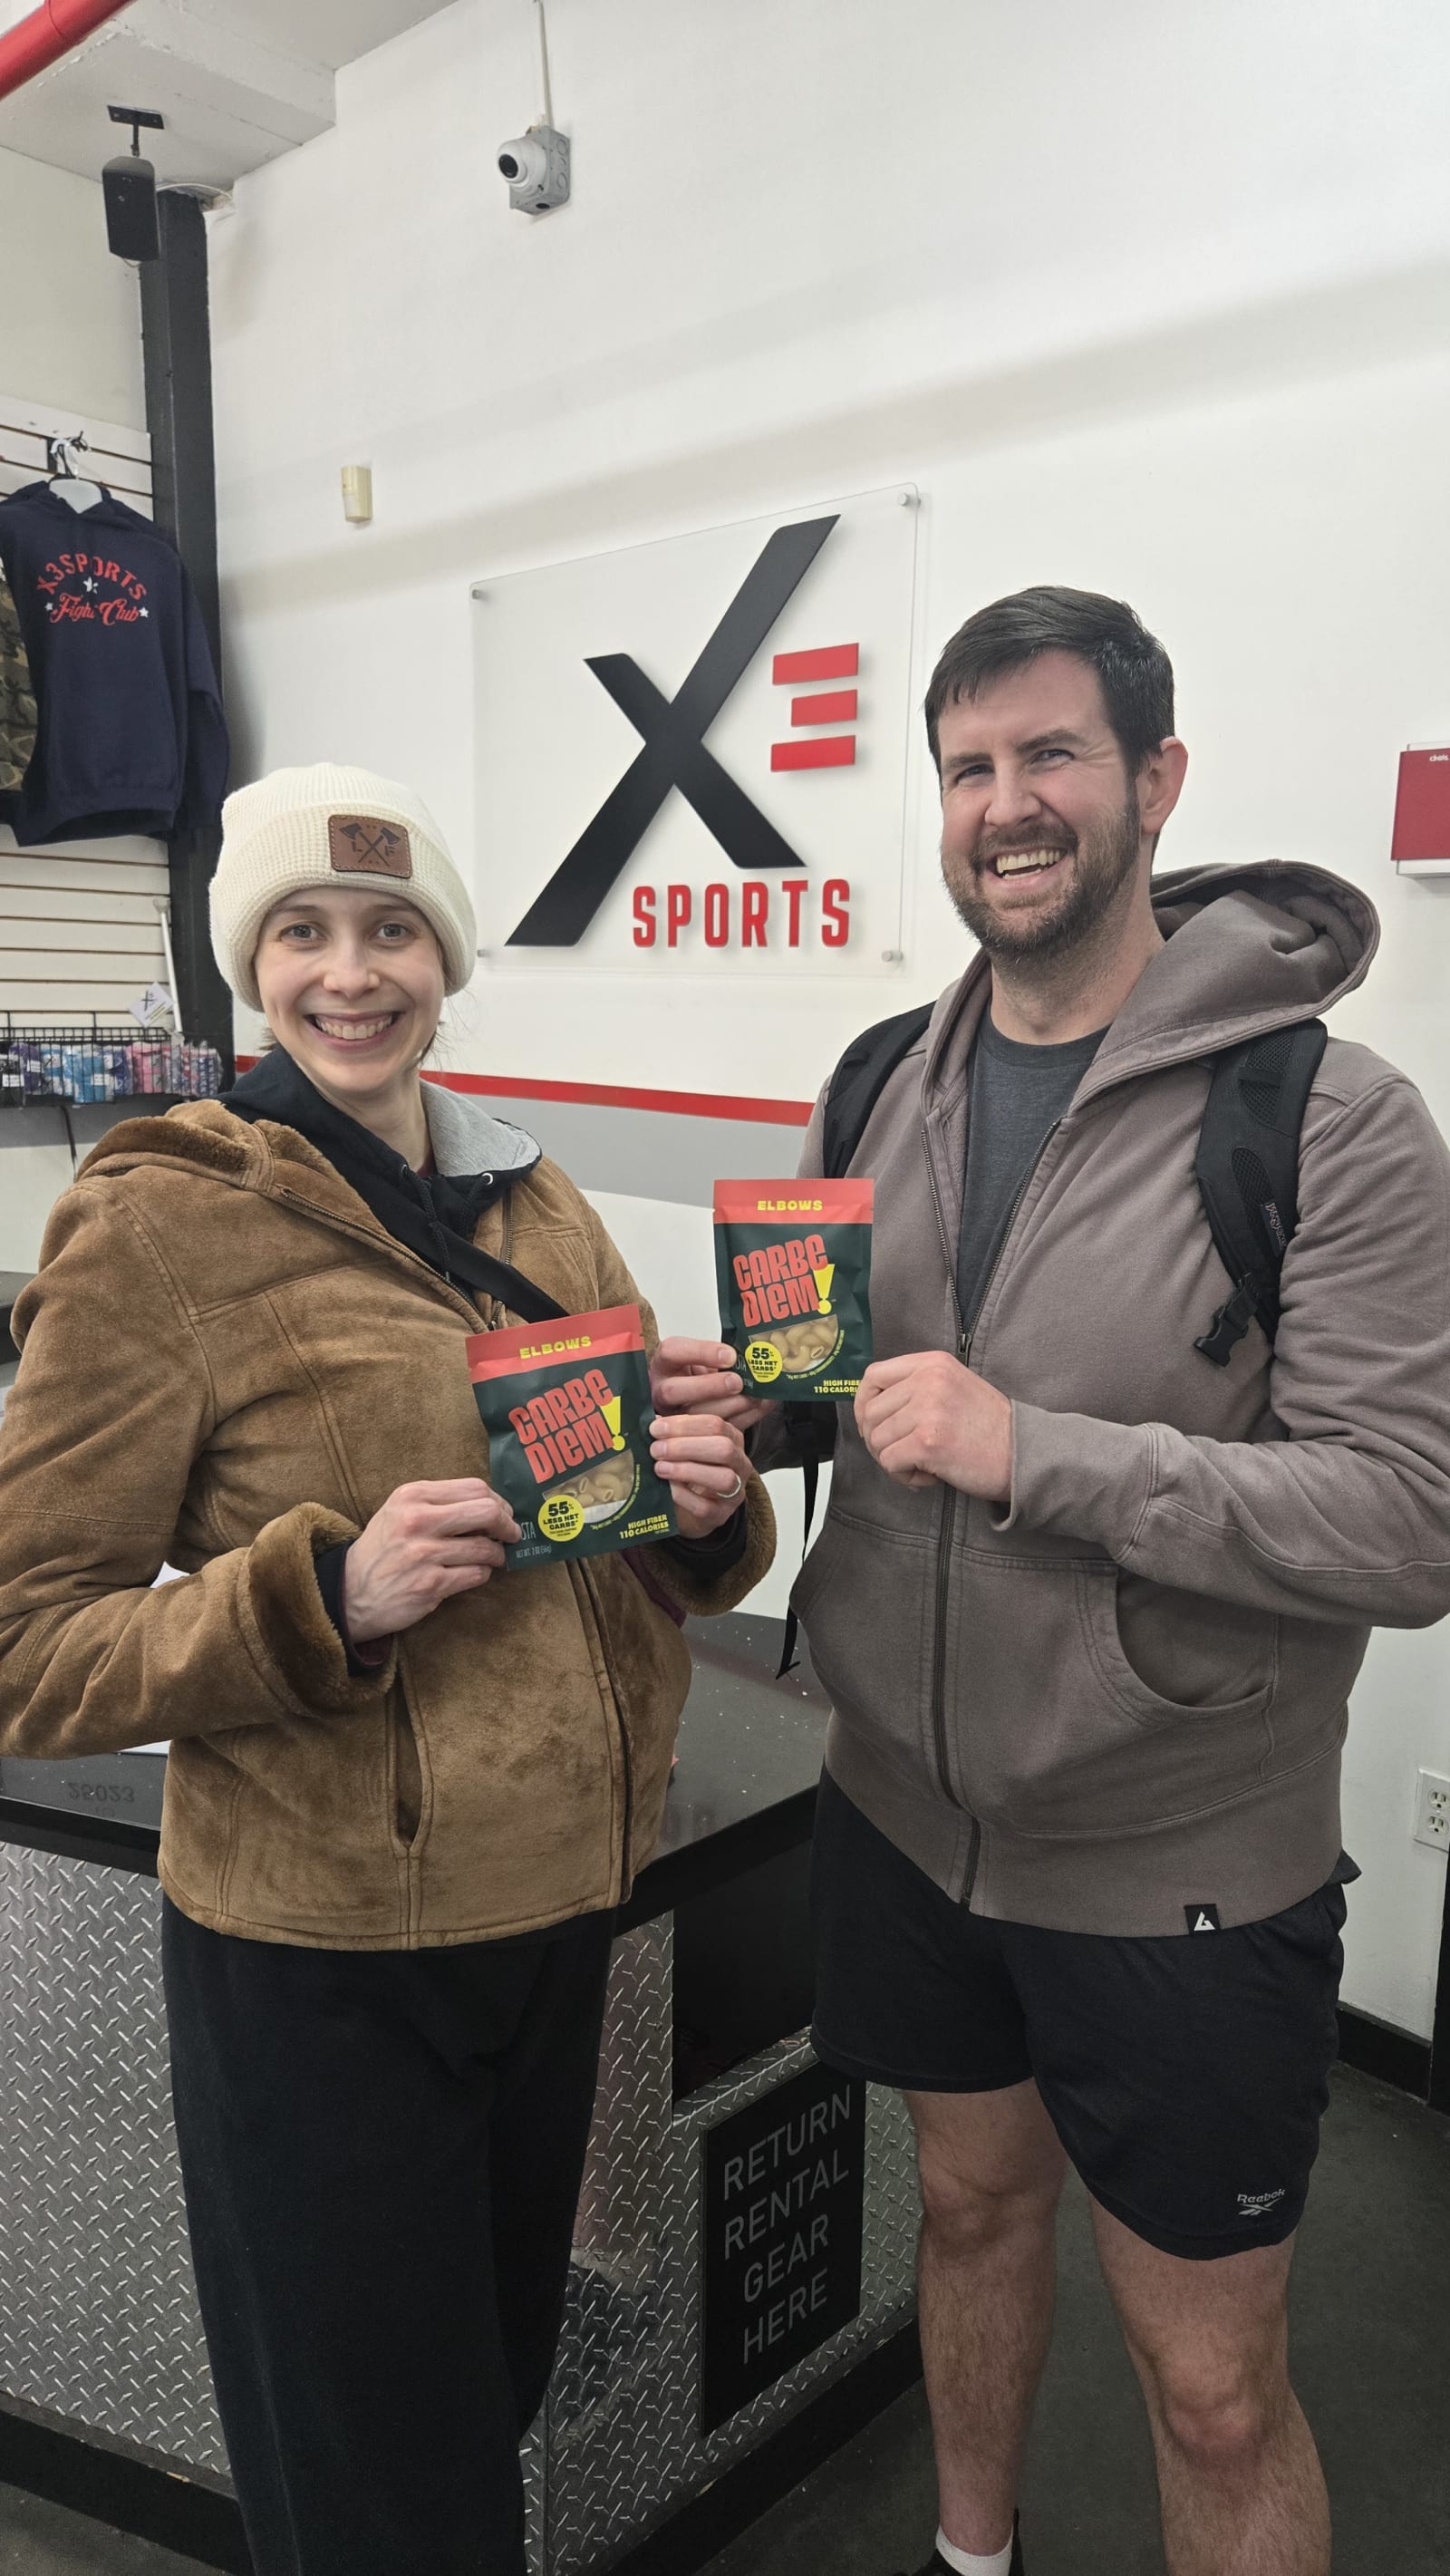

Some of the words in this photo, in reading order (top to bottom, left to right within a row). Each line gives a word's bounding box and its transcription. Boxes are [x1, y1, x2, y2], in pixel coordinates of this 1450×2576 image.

[99, 598, 140, 626] Club
[633, 878, 851, 948] SPORTS
[757, 1200, 823, 1211] ELBOWS
[519, 1336, 592, 1360] ELBOWS
[543, 1516, 564, 1525] LESS
[564, 1513, 580, 1522] NET
[619, 1529, 634, 1539] 110
[635, 1521, 670, 1535] CALORIES
[628, 1518, 646, 1530] HIGH
[647, 1514, 668, 1525] FIBER
[724, 2085, 851, 2201] RETURN
[724, 2149, 849, 2260] RENTAL
[1237, 2188, 1286, 2203] Reebok
[744, 2213, 829, 2303] GEAR
[743, 2269, 828, 2364] HERE
